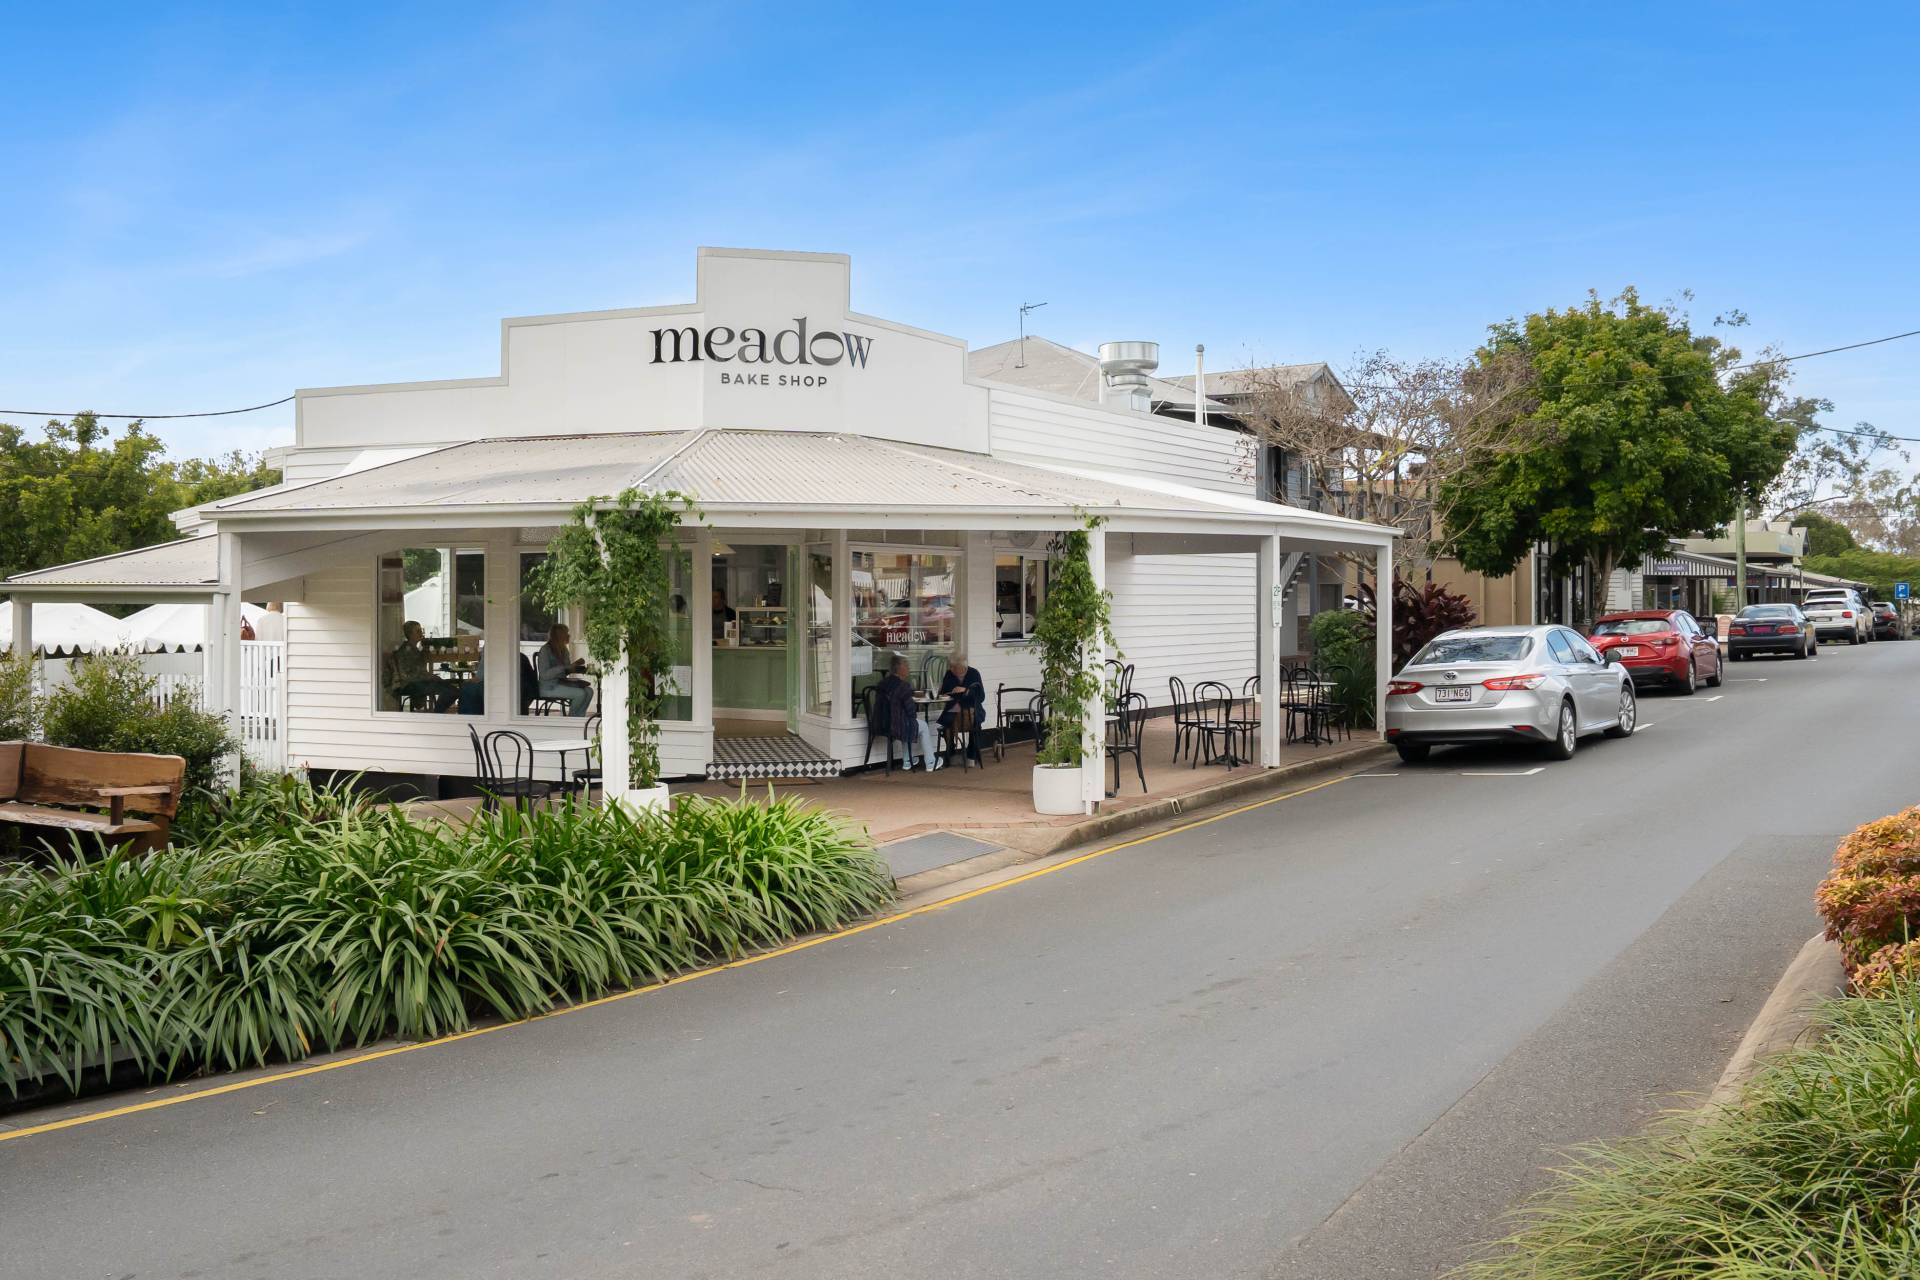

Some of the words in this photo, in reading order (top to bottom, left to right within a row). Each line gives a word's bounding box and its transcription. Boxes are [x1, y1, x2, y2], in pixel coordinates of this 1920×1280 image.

[648, 316, 875, 370] meadow
[720, 372, 770, 386] BAKE
[778, 374, 828, 388] SHOP
[886, 629, 928, 642] meadow
[1437, 690, 1449, 698] 731
